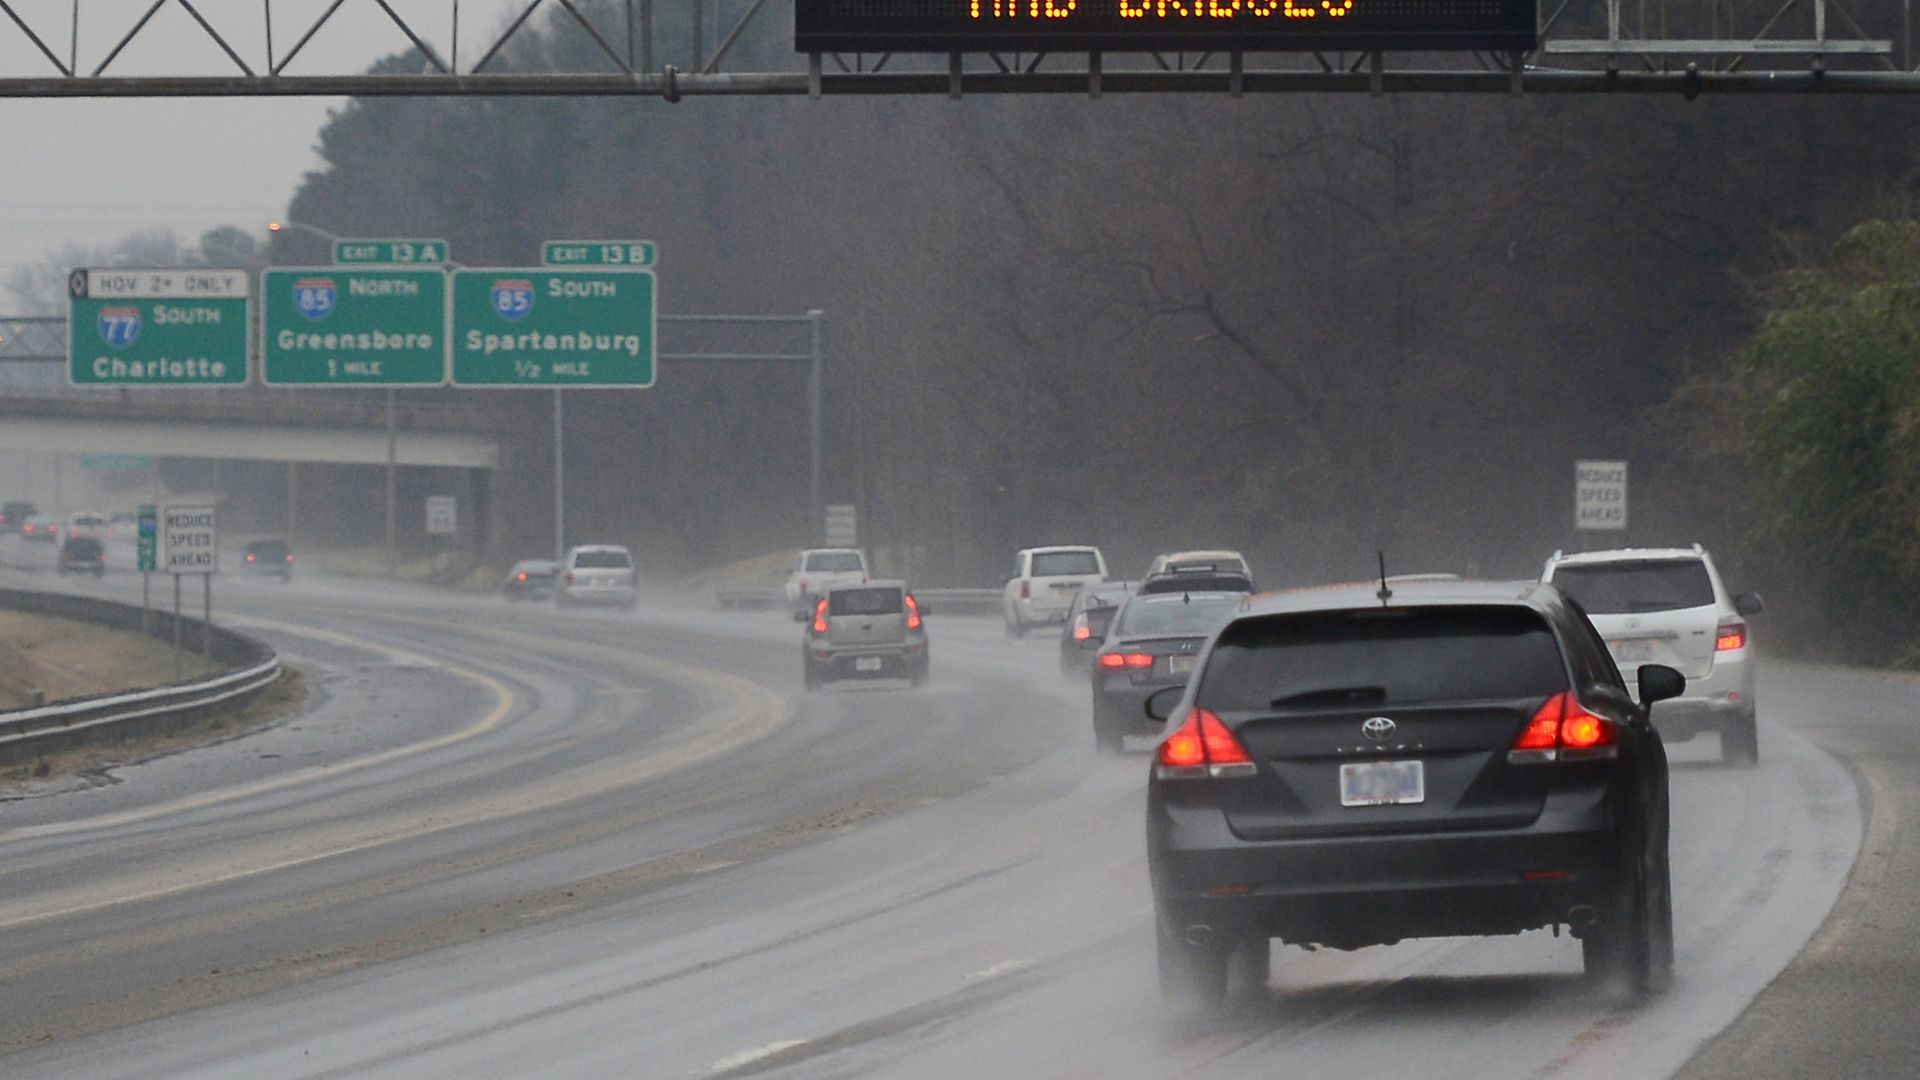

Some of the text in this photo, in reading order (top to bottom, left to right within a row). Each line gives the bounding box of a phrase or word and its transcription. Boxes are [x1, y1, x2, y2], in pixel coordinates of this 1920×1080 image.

[342, 246, 377, 260] EXIT
[553, 247, 588, 261] EXIT
[101, 276, 137, 291] HOV
[185, 276, 233, 291] ONLY
[349, 277, 419, 296] NORTH
[548, 278, 617, 298] SOUTH
[301, 288, 332, 312] 85
[498, 290, 530, 312] 85
[153, 305, 222, 324] SOUTH
[102, 316, 136, 340] 77
[278, 329, 433, 350] Greensboro
[466, 329, 641, 356] Spartanburg
[93, 356, 226, 378] Charlotte
[328, 358, 382, 377] 1 MILE
[552, 362, 590, 376] MILE
[1581, 488, 1621, 502] SPEED
[167, 514, 213, 528] REDUCE
[170, 533, 210, 547] SPEED
[169, 553, 211, 566] AHEAD
